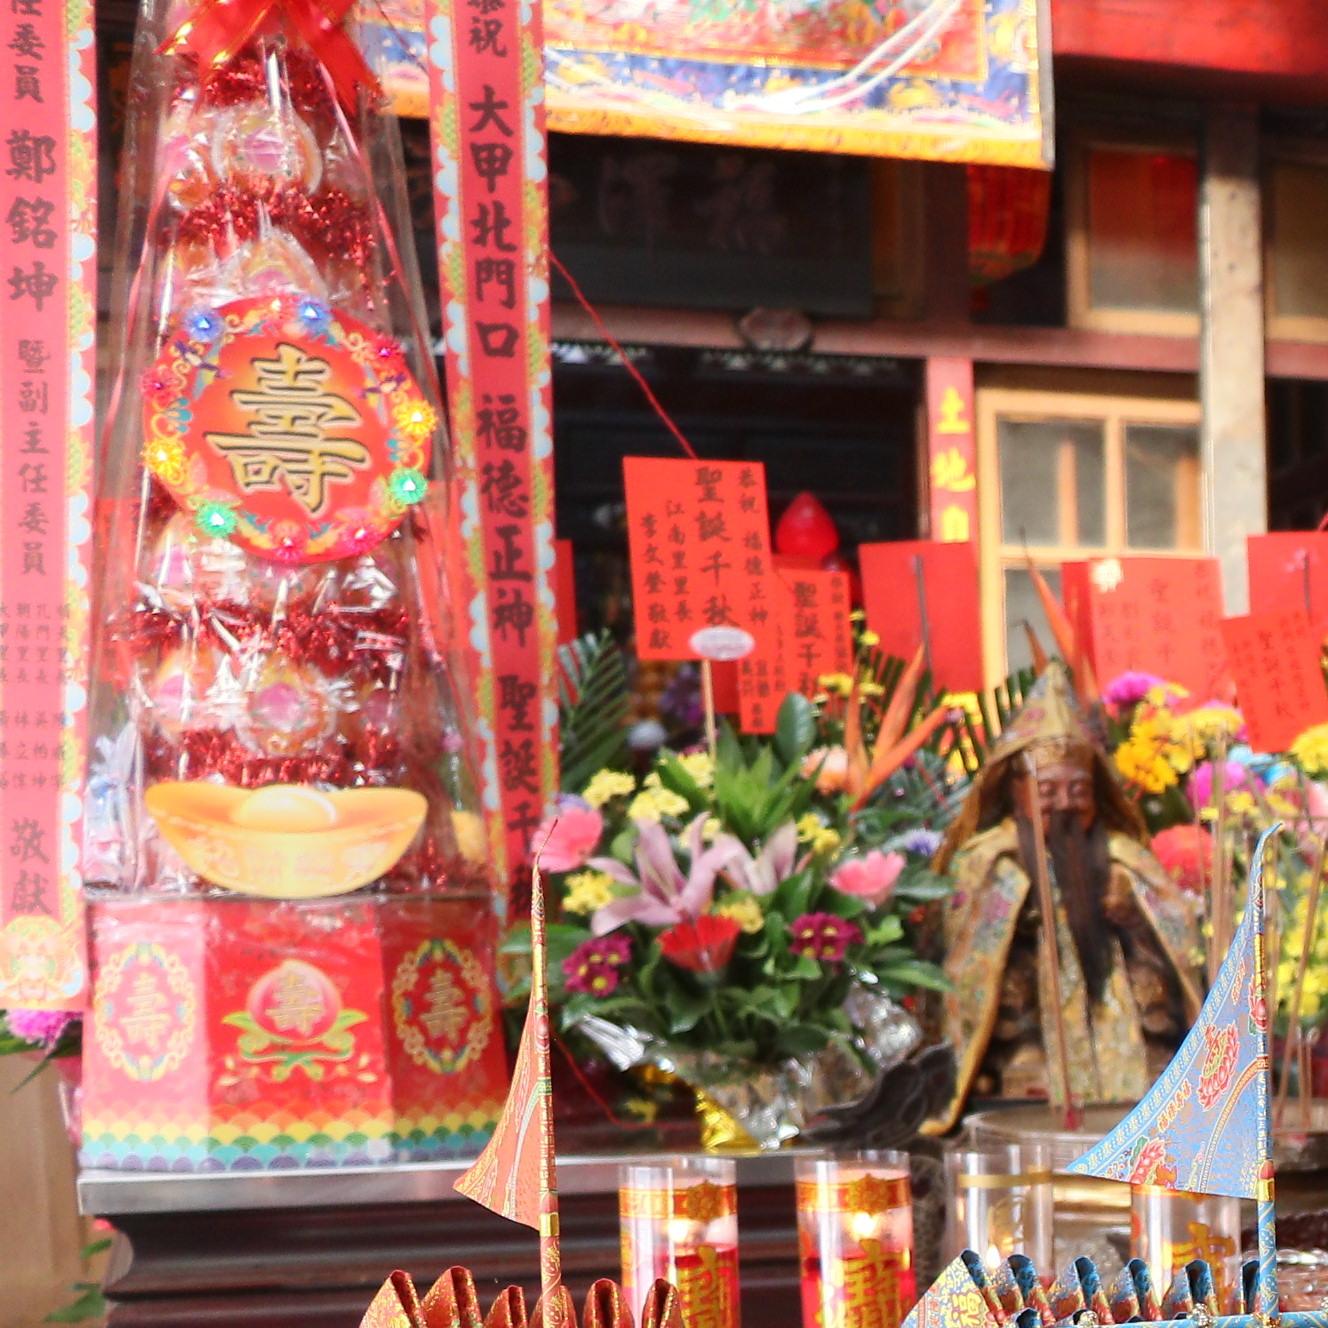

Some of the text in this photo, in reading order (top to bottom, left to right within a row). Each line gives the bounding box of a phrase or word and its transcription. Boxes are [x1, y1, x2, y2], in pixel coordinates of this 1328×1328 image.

[4, 128, 58, 312] 鄭銘坤
[467, 84, 520, 358] 大甲北門口
[204, 342, 370, 515] 壽
[475, 394, 535, 648] 福德正神
